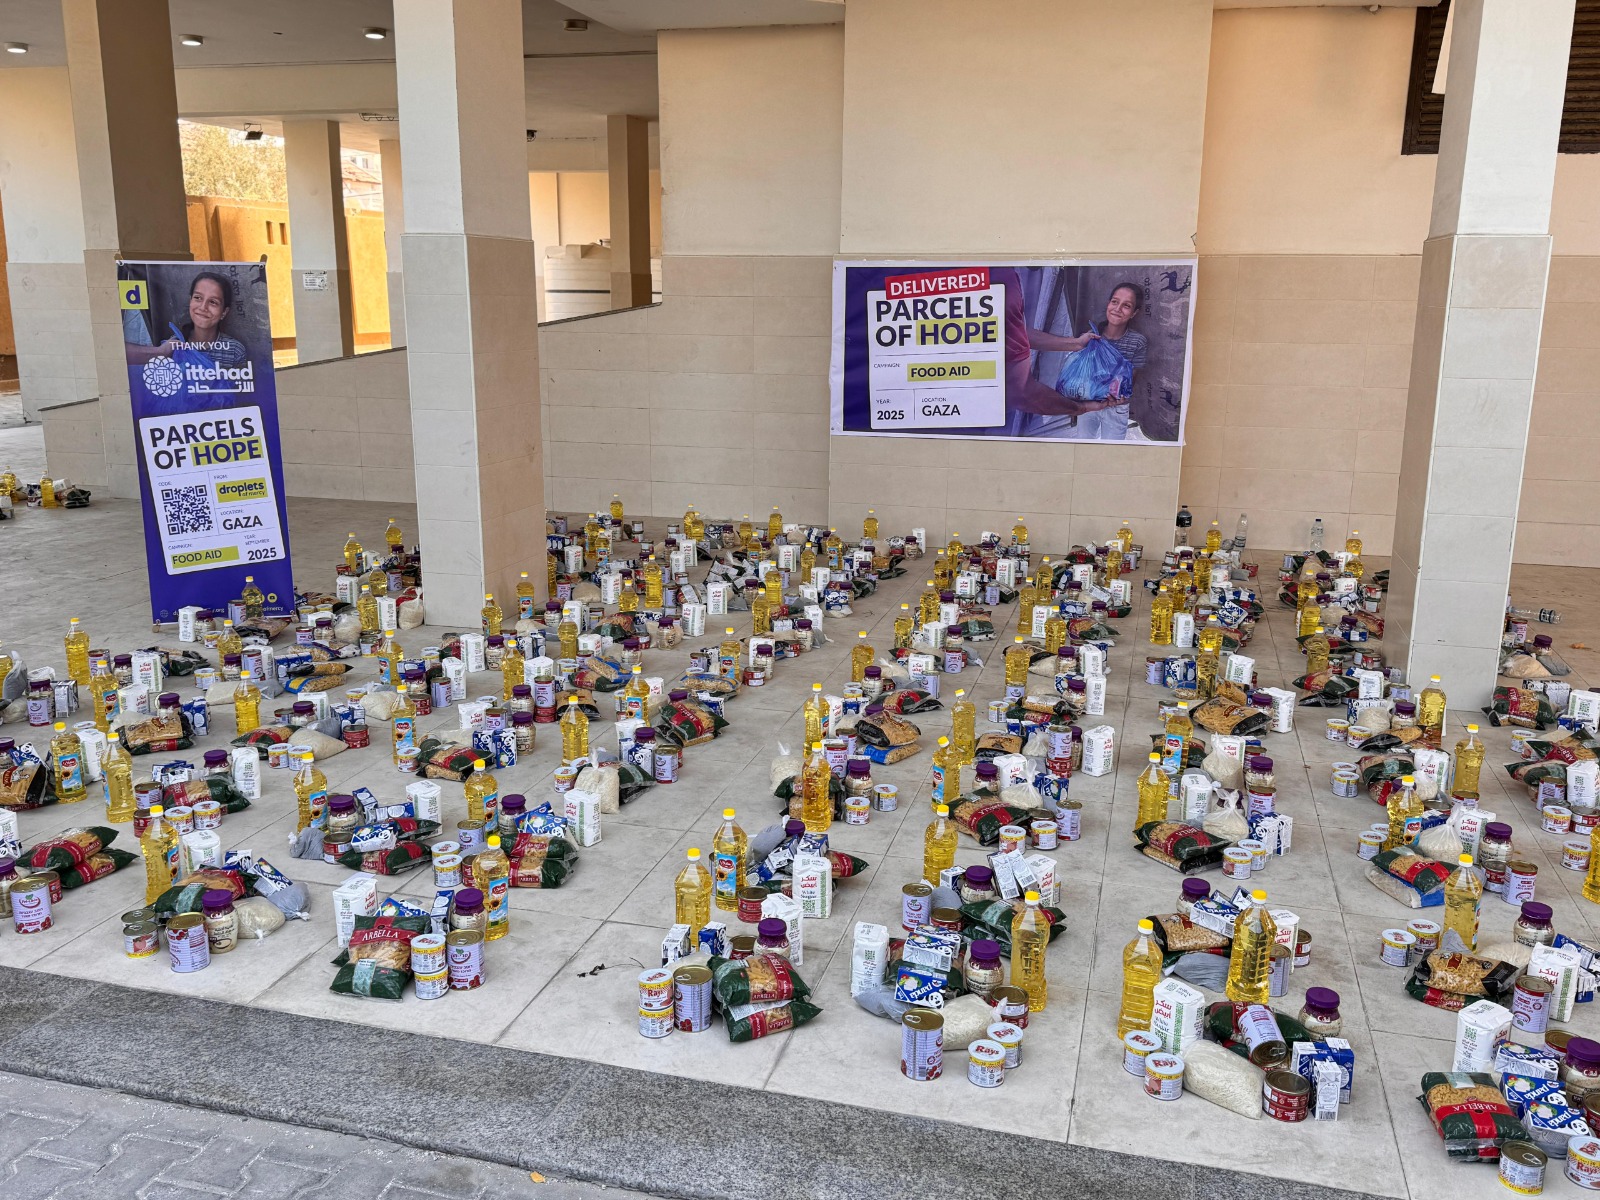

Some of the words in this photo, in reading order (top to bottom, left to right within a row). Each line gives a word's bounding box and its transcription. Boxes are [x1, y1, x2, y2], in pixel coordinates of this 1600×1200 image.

[890, 272, 985, 296] DELIVERED!
[876, 295, 994, 322] PARCELS
[875, 324, 912, 347] OF
[920, 321, 997, 345] HOPE
[170, 341, 206, 351] THANK
[208, 341, 230, 350] YOU
[185, 361, 253, 380] ittehad
[911, 367, 946, 378] FOOD
[949, 366, 970, 376] AID
[877, 410, 905, 420] 2025
[922, 404, 960, 416] GAZA
[150, 417, 255, 447] PARCELS
[154, 448, 187, 469] OF
[193, 439, 262, 466] HOPE
[219, 481, 264, 497] droplets
[223, 515, 263, 530] GAZA
[172, 552, 202, 565] FOOD
[204, 550, 222, 560] AID
[248, 547, 277, 561] 2025
[801, 874, 817, 883] سكر
[362, 929, 400, 942] ARBELLA
[1538, 968, 1559, 977] سكر
[909, 982, 933, 999] panda
[1156, 1000, 1172, 1010] سكر
[993, 1028, 1015, 1039] Rays
[1132, 1034, 1155, 1047] Rays
[975, 1045, 999, 1055] Rays
[1152, 1059, 1177, 1068] Rays
[1523, 1084, 1549, 1100] panda
[1452, 1104, 1498, 1112] ARBELLA
[1547, 1110, 1570, 1127] panda
